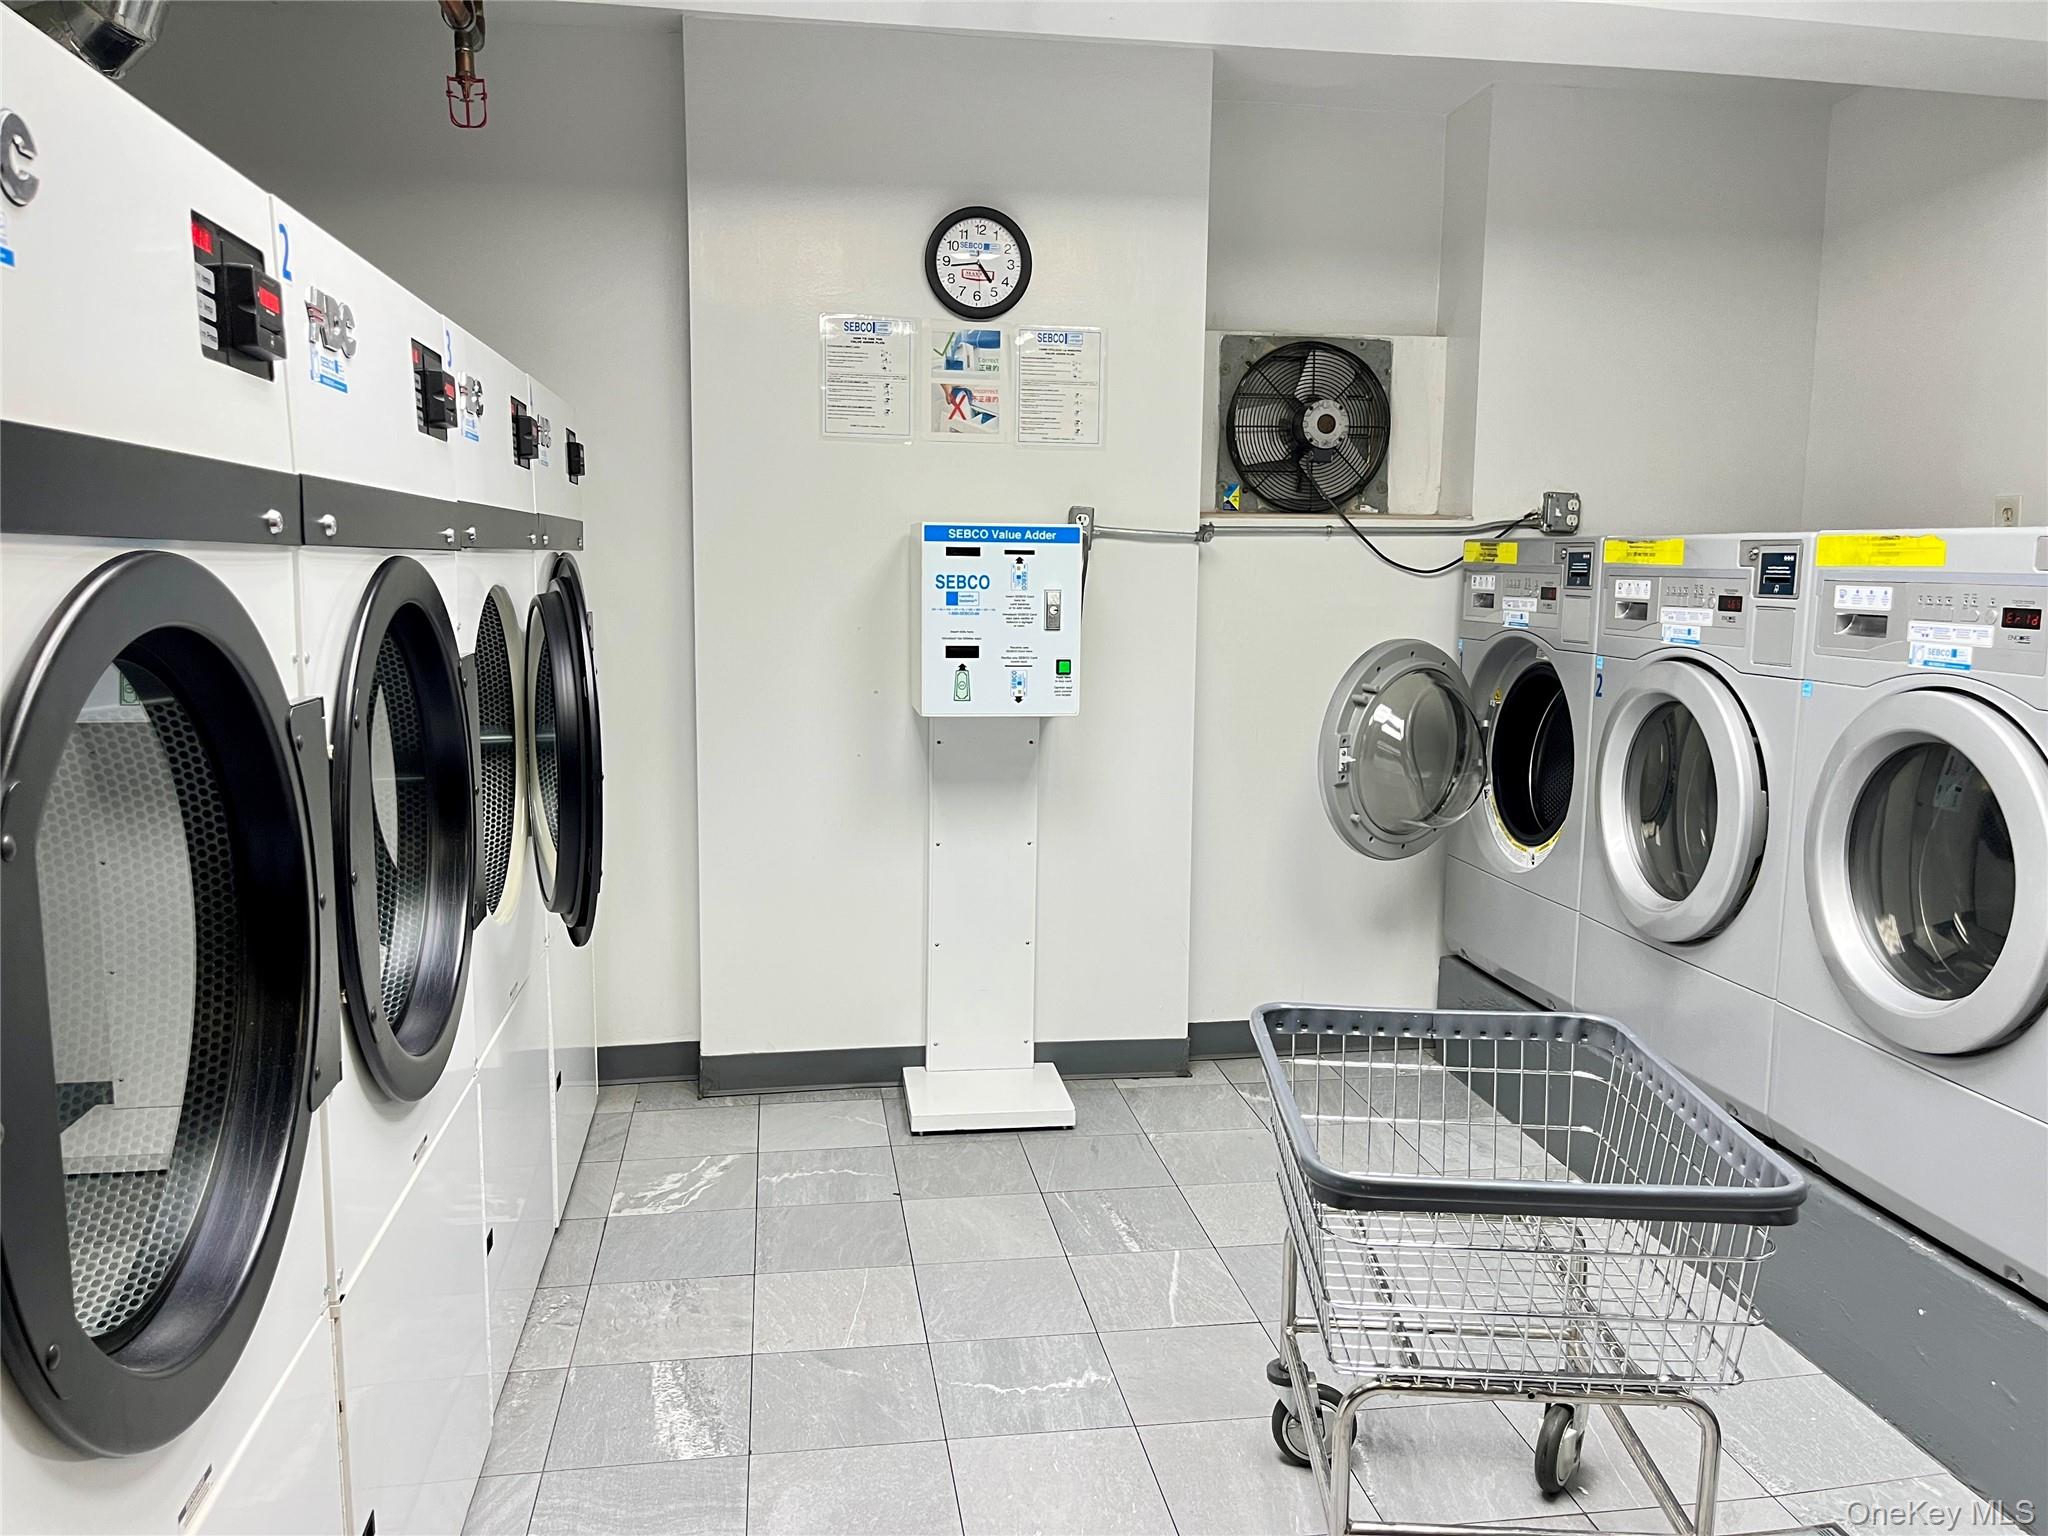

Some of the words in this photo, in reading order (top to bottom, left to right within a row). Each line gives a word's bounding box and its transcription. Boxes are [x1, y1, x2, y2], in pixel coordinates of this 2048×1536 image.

[959, 229, 969, 240] 11
[974, 224, 987, 236] 12
[993, 230, 998, 241] 1
[947, 240, 960, 252] 10
[960, 241, 983, 250] SEBCO
[1004, 244, 1011, 255] 2
[278, 223, 293, 282] 2
[942, 255, 951, 267] 9
[1006, 259, 1015, 271] 3
[947, 272, 956, 284] 8
[1001, 276, 1010, 287] 4
[958, 285, 967, 297] 7
[972, 290, 982, 302] 6
[989, 286, 998, 298] 5
[843, 321, 872, 332] SEBCO
[1037, 332, 1065, 343] SEBCO
[948, 528, 989, 539] SEBCO
[991, 529, 1022, 539] Value
[1024, 530, 1057, 540] Adder
[935, 574, 990, 589] SEBCO
[1595, 673, 1603, 697] 2
